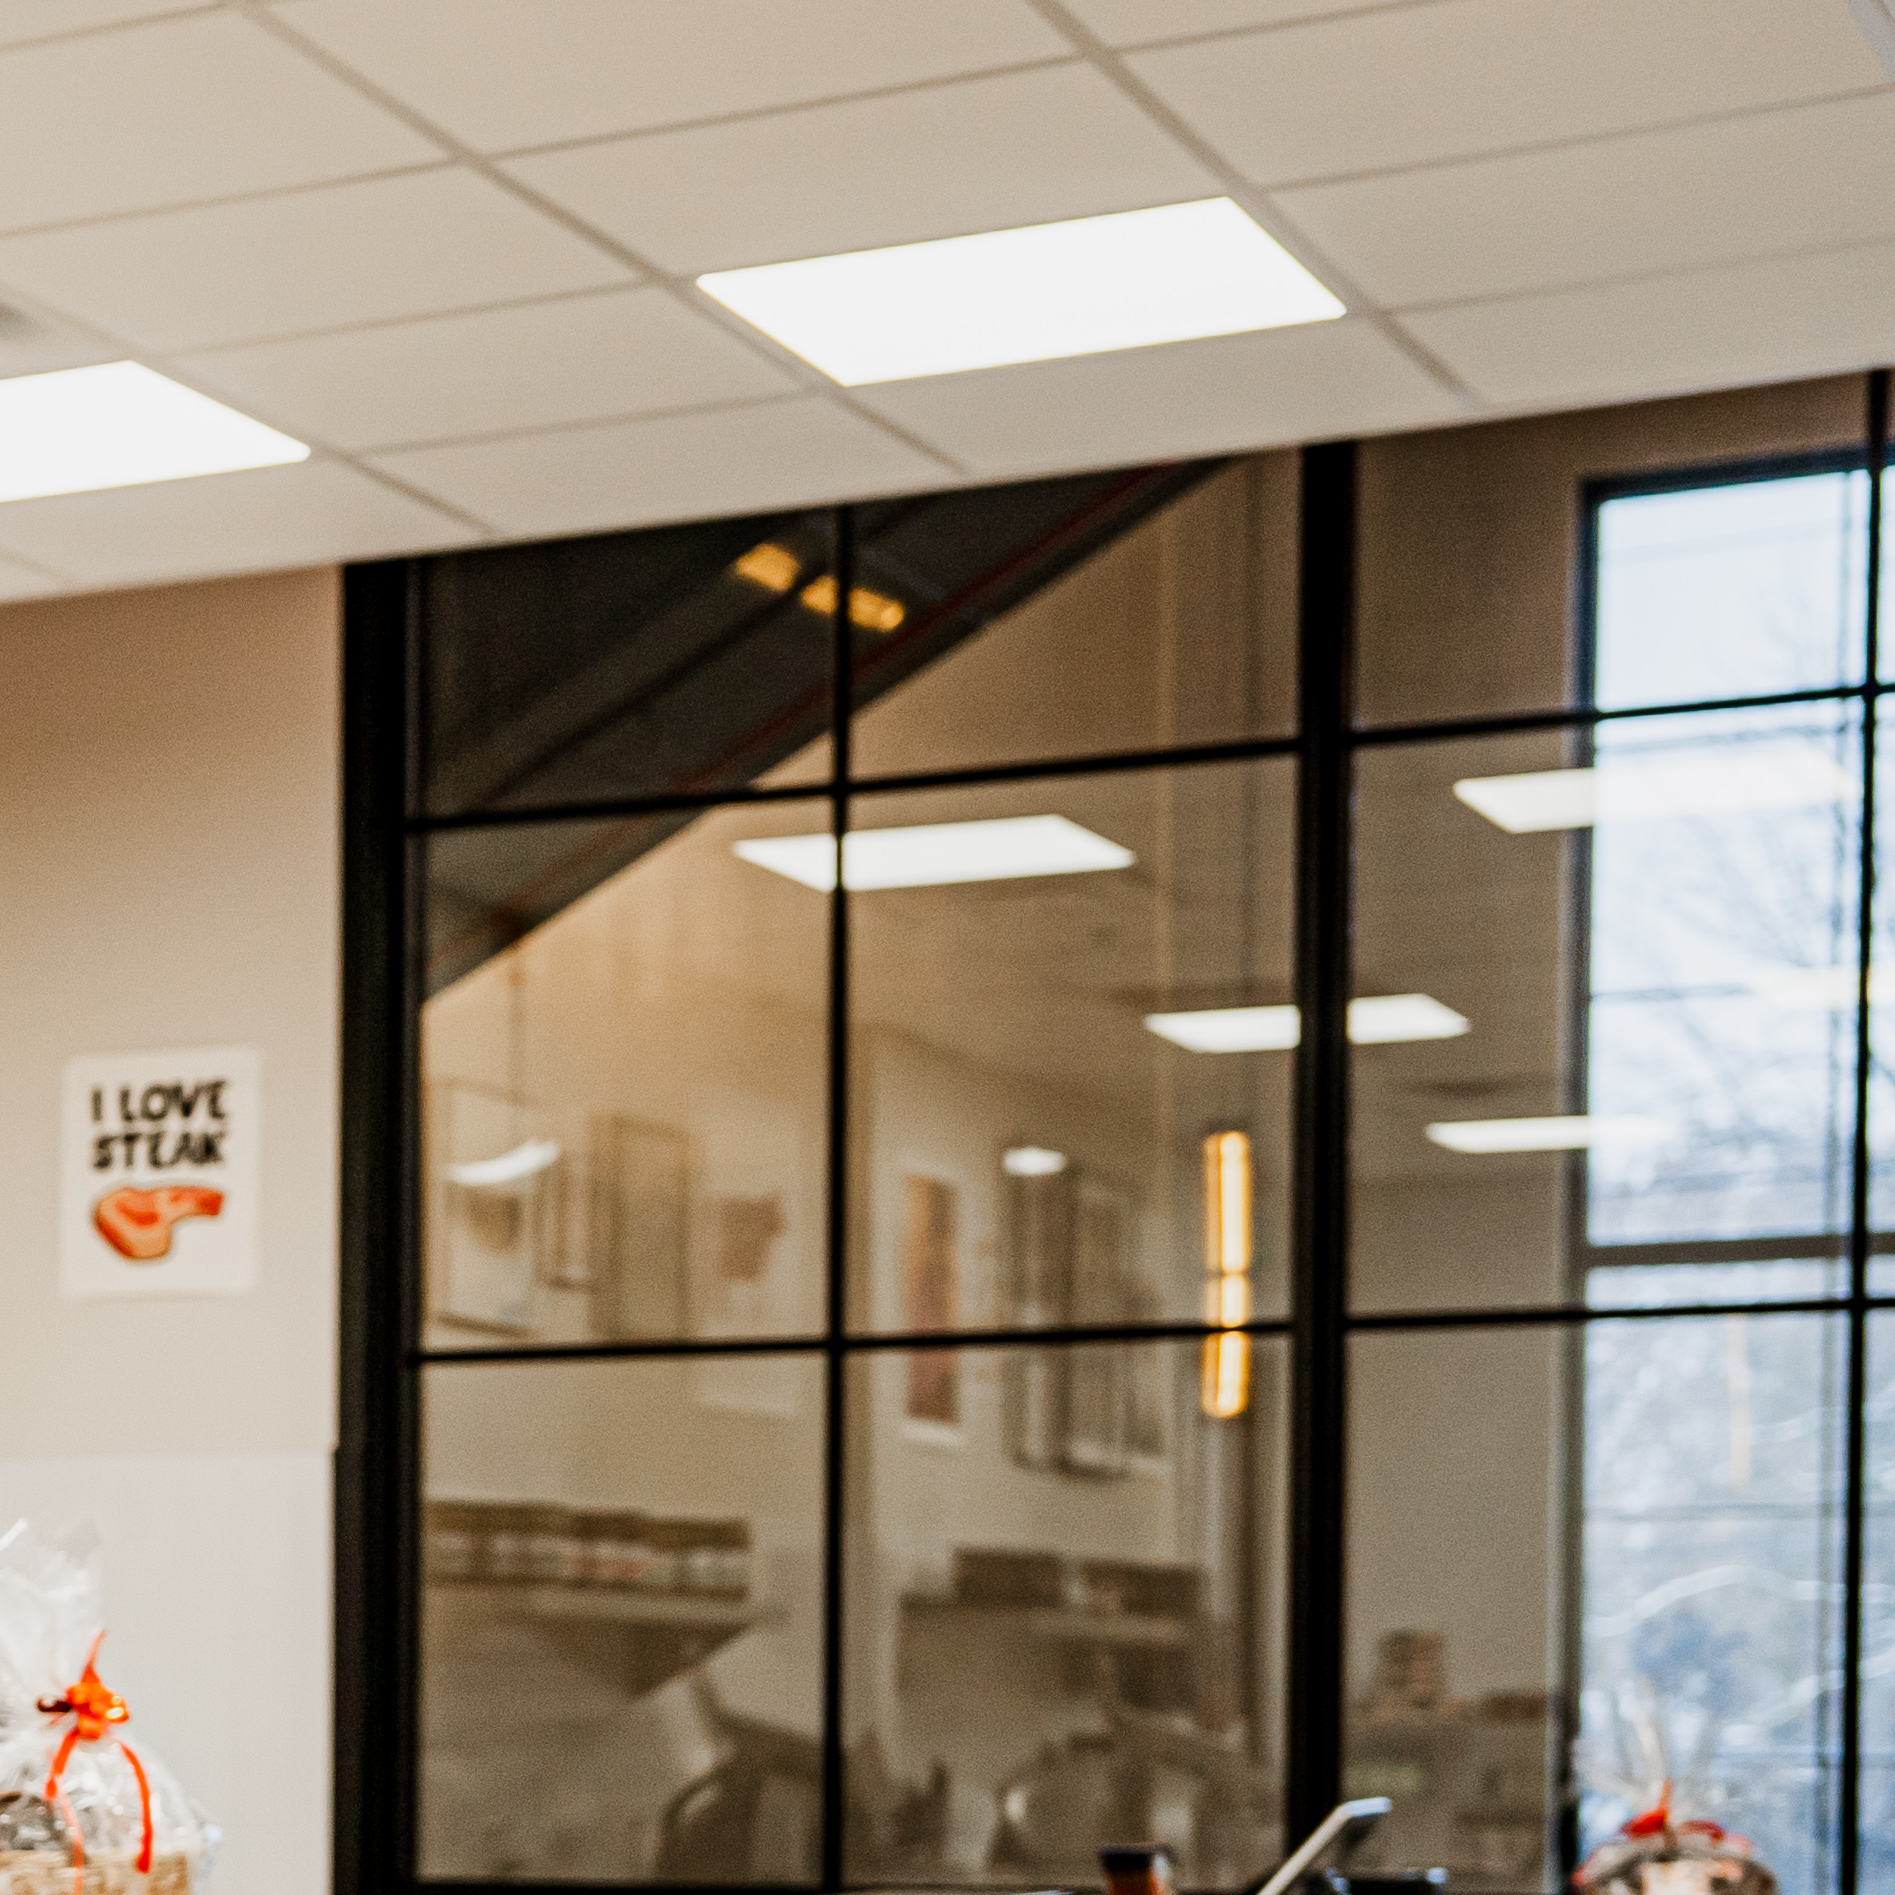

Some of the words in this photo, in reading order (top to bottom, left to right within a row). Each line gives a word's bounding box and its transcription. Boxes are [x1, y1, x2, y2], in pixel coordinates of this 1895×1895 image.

[90, 1084, 103, 1124] I
[118, 1078, 226, 1122] LOVE
[92, 1130, 226, 1171] STEAK
